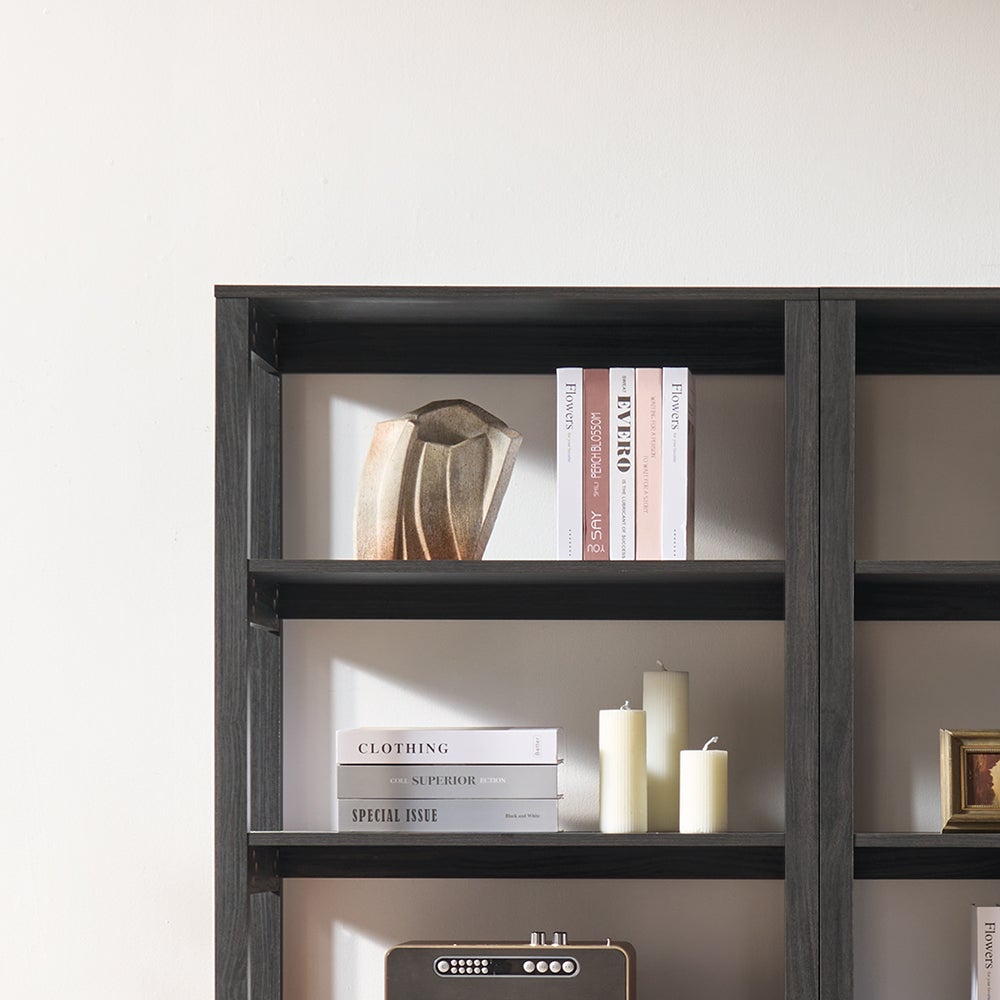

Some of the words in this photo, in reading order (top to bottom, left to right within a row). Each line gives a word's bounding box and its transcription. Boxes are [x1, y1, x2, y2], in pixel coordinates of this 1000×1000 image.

[565, 383, 577, 431] Flowers
[671, 383, 683, 430] Flowers
[590, 412, 602, 452] BLOSSOM
[617, 395, 631, 474] EVERO
[590, 453, 602, 479] PEACH
[590, 510, 602, 541] SAY
[586, 543, 606, 553] YOU
[358, 743, 449, 754] CLOTHING
[411, 775, 477, 786] SUPERIOR
[352, 808, 400, 823] SPECIAL
[406, 808, 438, 823] ISSUE
[984, 922, 996, 970] Flowers
